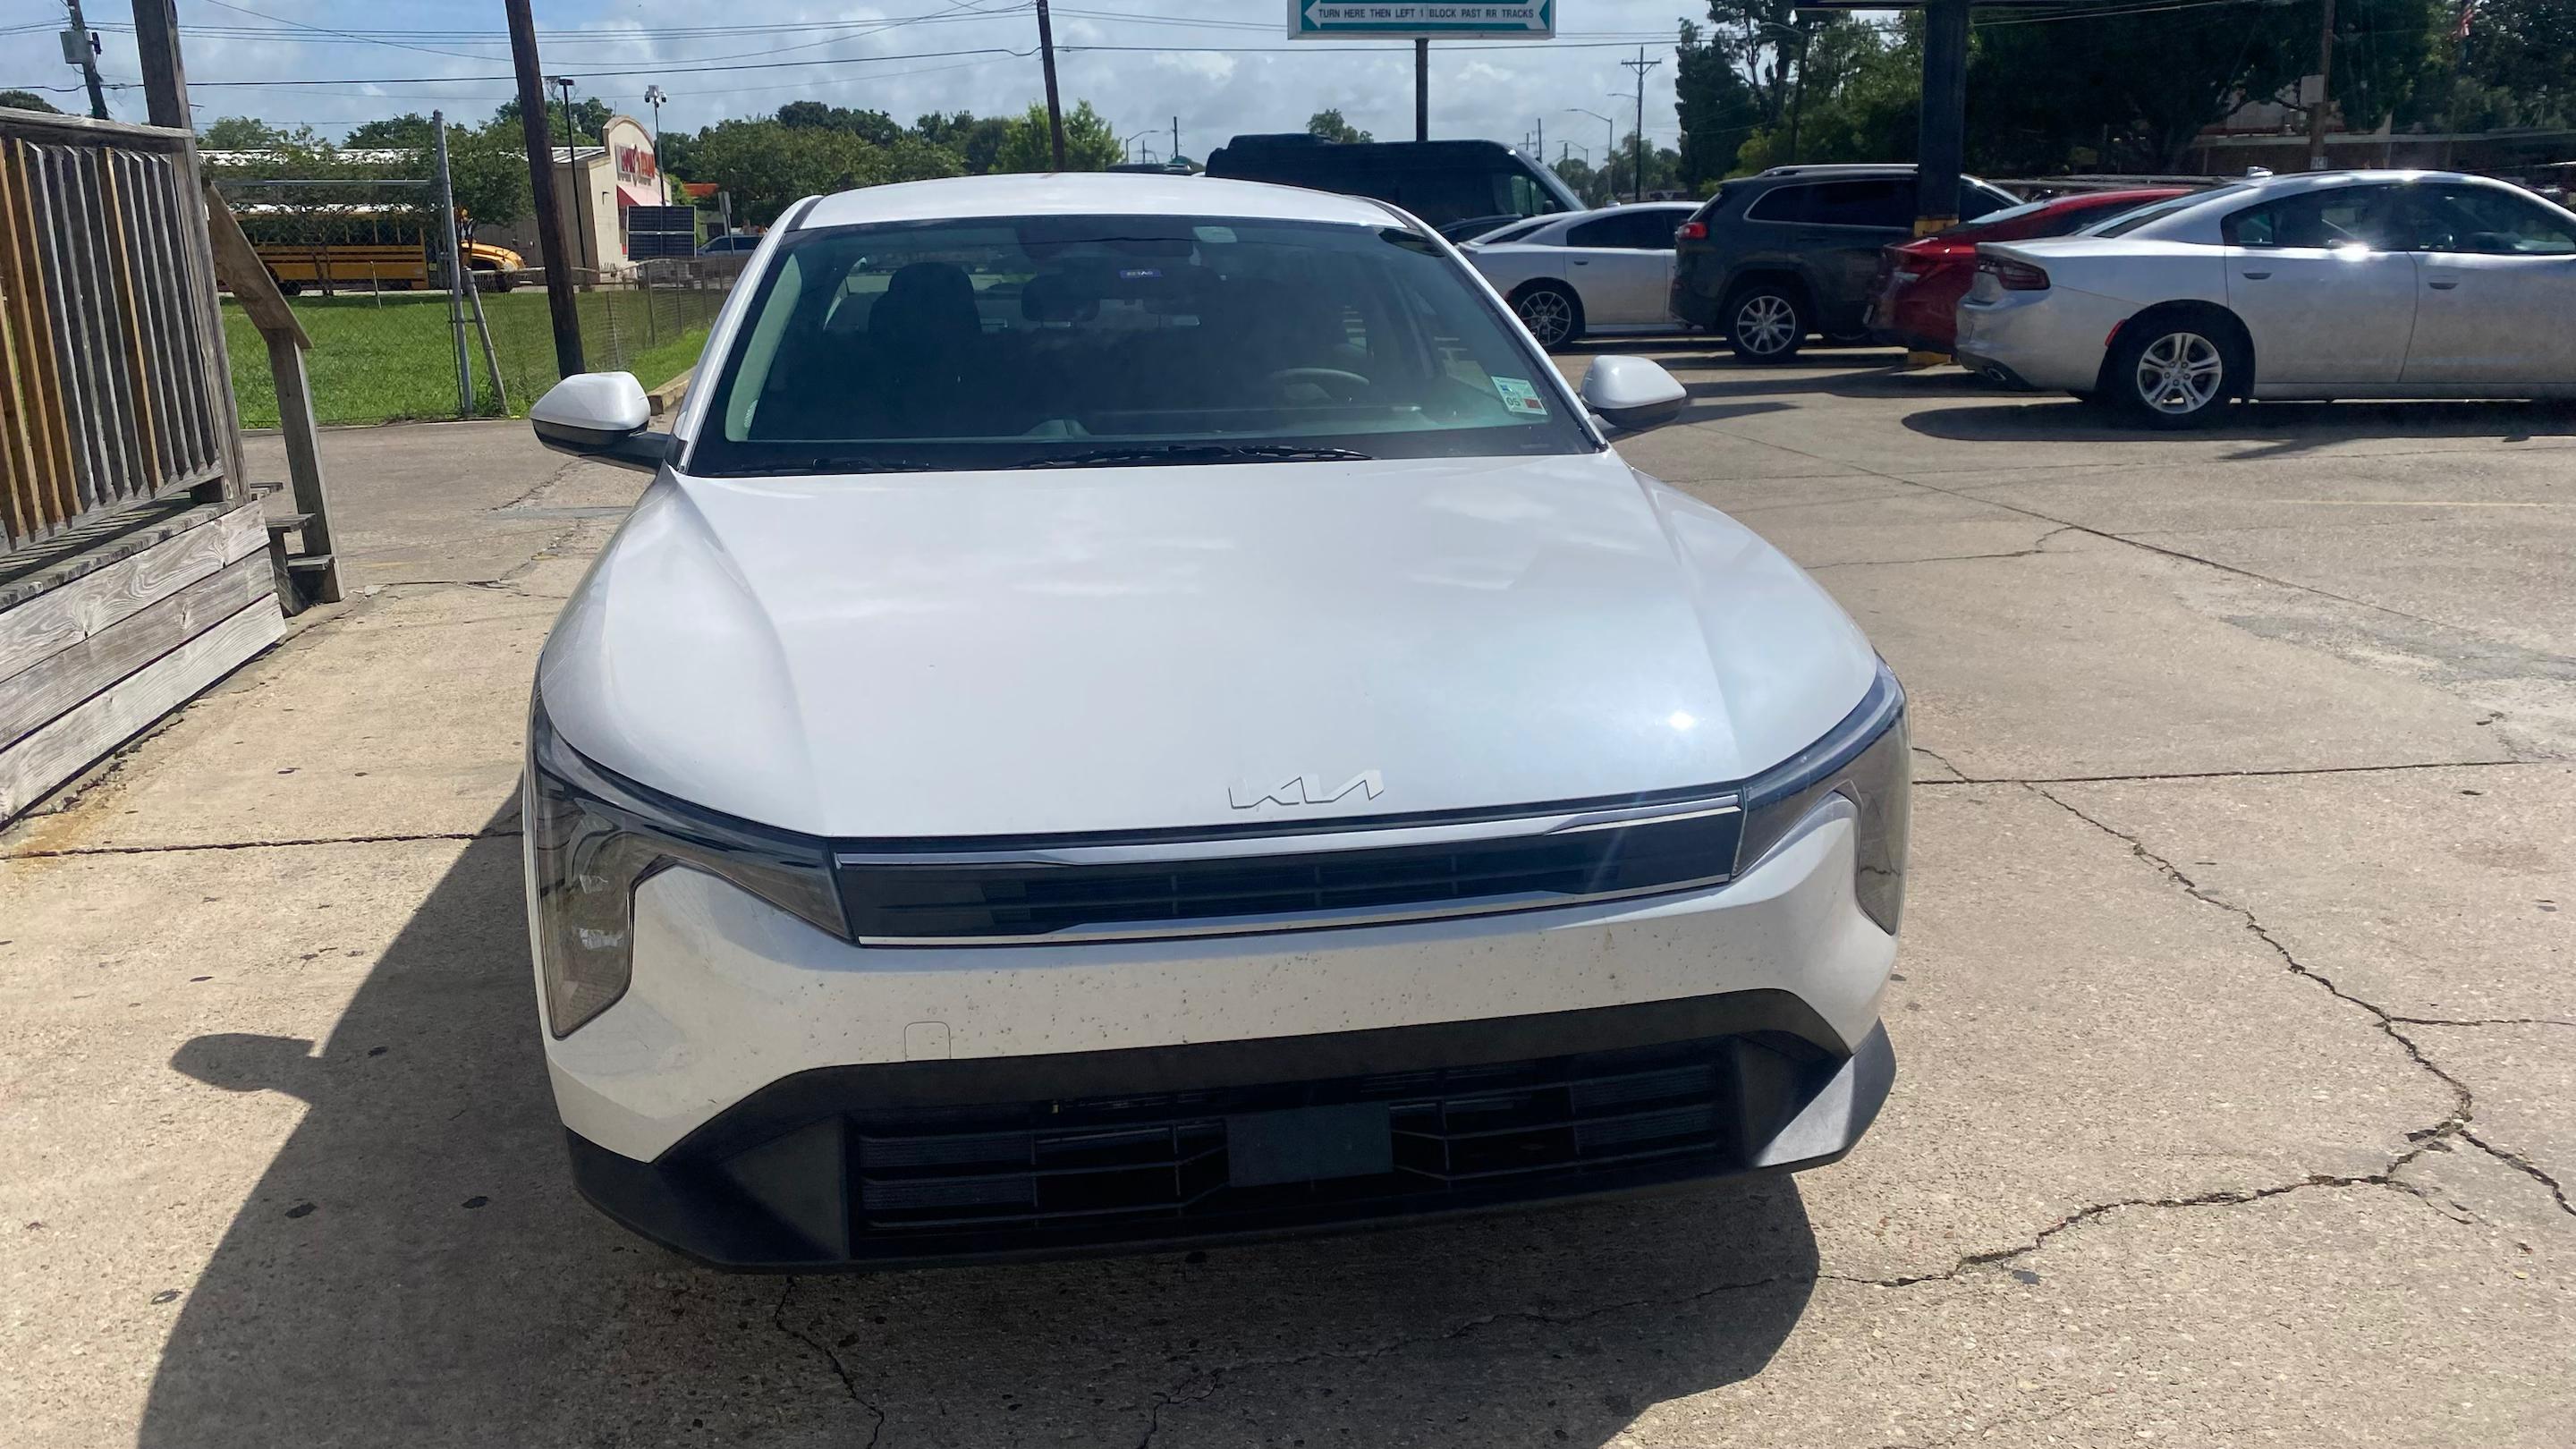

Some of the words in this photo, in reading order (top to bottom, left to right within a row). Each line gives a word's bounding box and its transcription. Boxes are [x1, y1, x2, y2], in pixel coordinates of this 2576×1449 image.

[1318, 9, 1340, 18] TURN
[1344, 9, 1365, 18] HERE
[1369, 9, 1391, 18] THEN
[1395, 9, 1415, 18] LEFT
[1429, 9, 1457, 18] BLOCK
[1462, 9, 1482, 18] PAST
[1486, 9, 1497, 18] RR
[1502, 9, 1534, 18] TRACKS
[1506, 396, 1521, 407] 05
[1228, 770, 1384, 809] KIA
